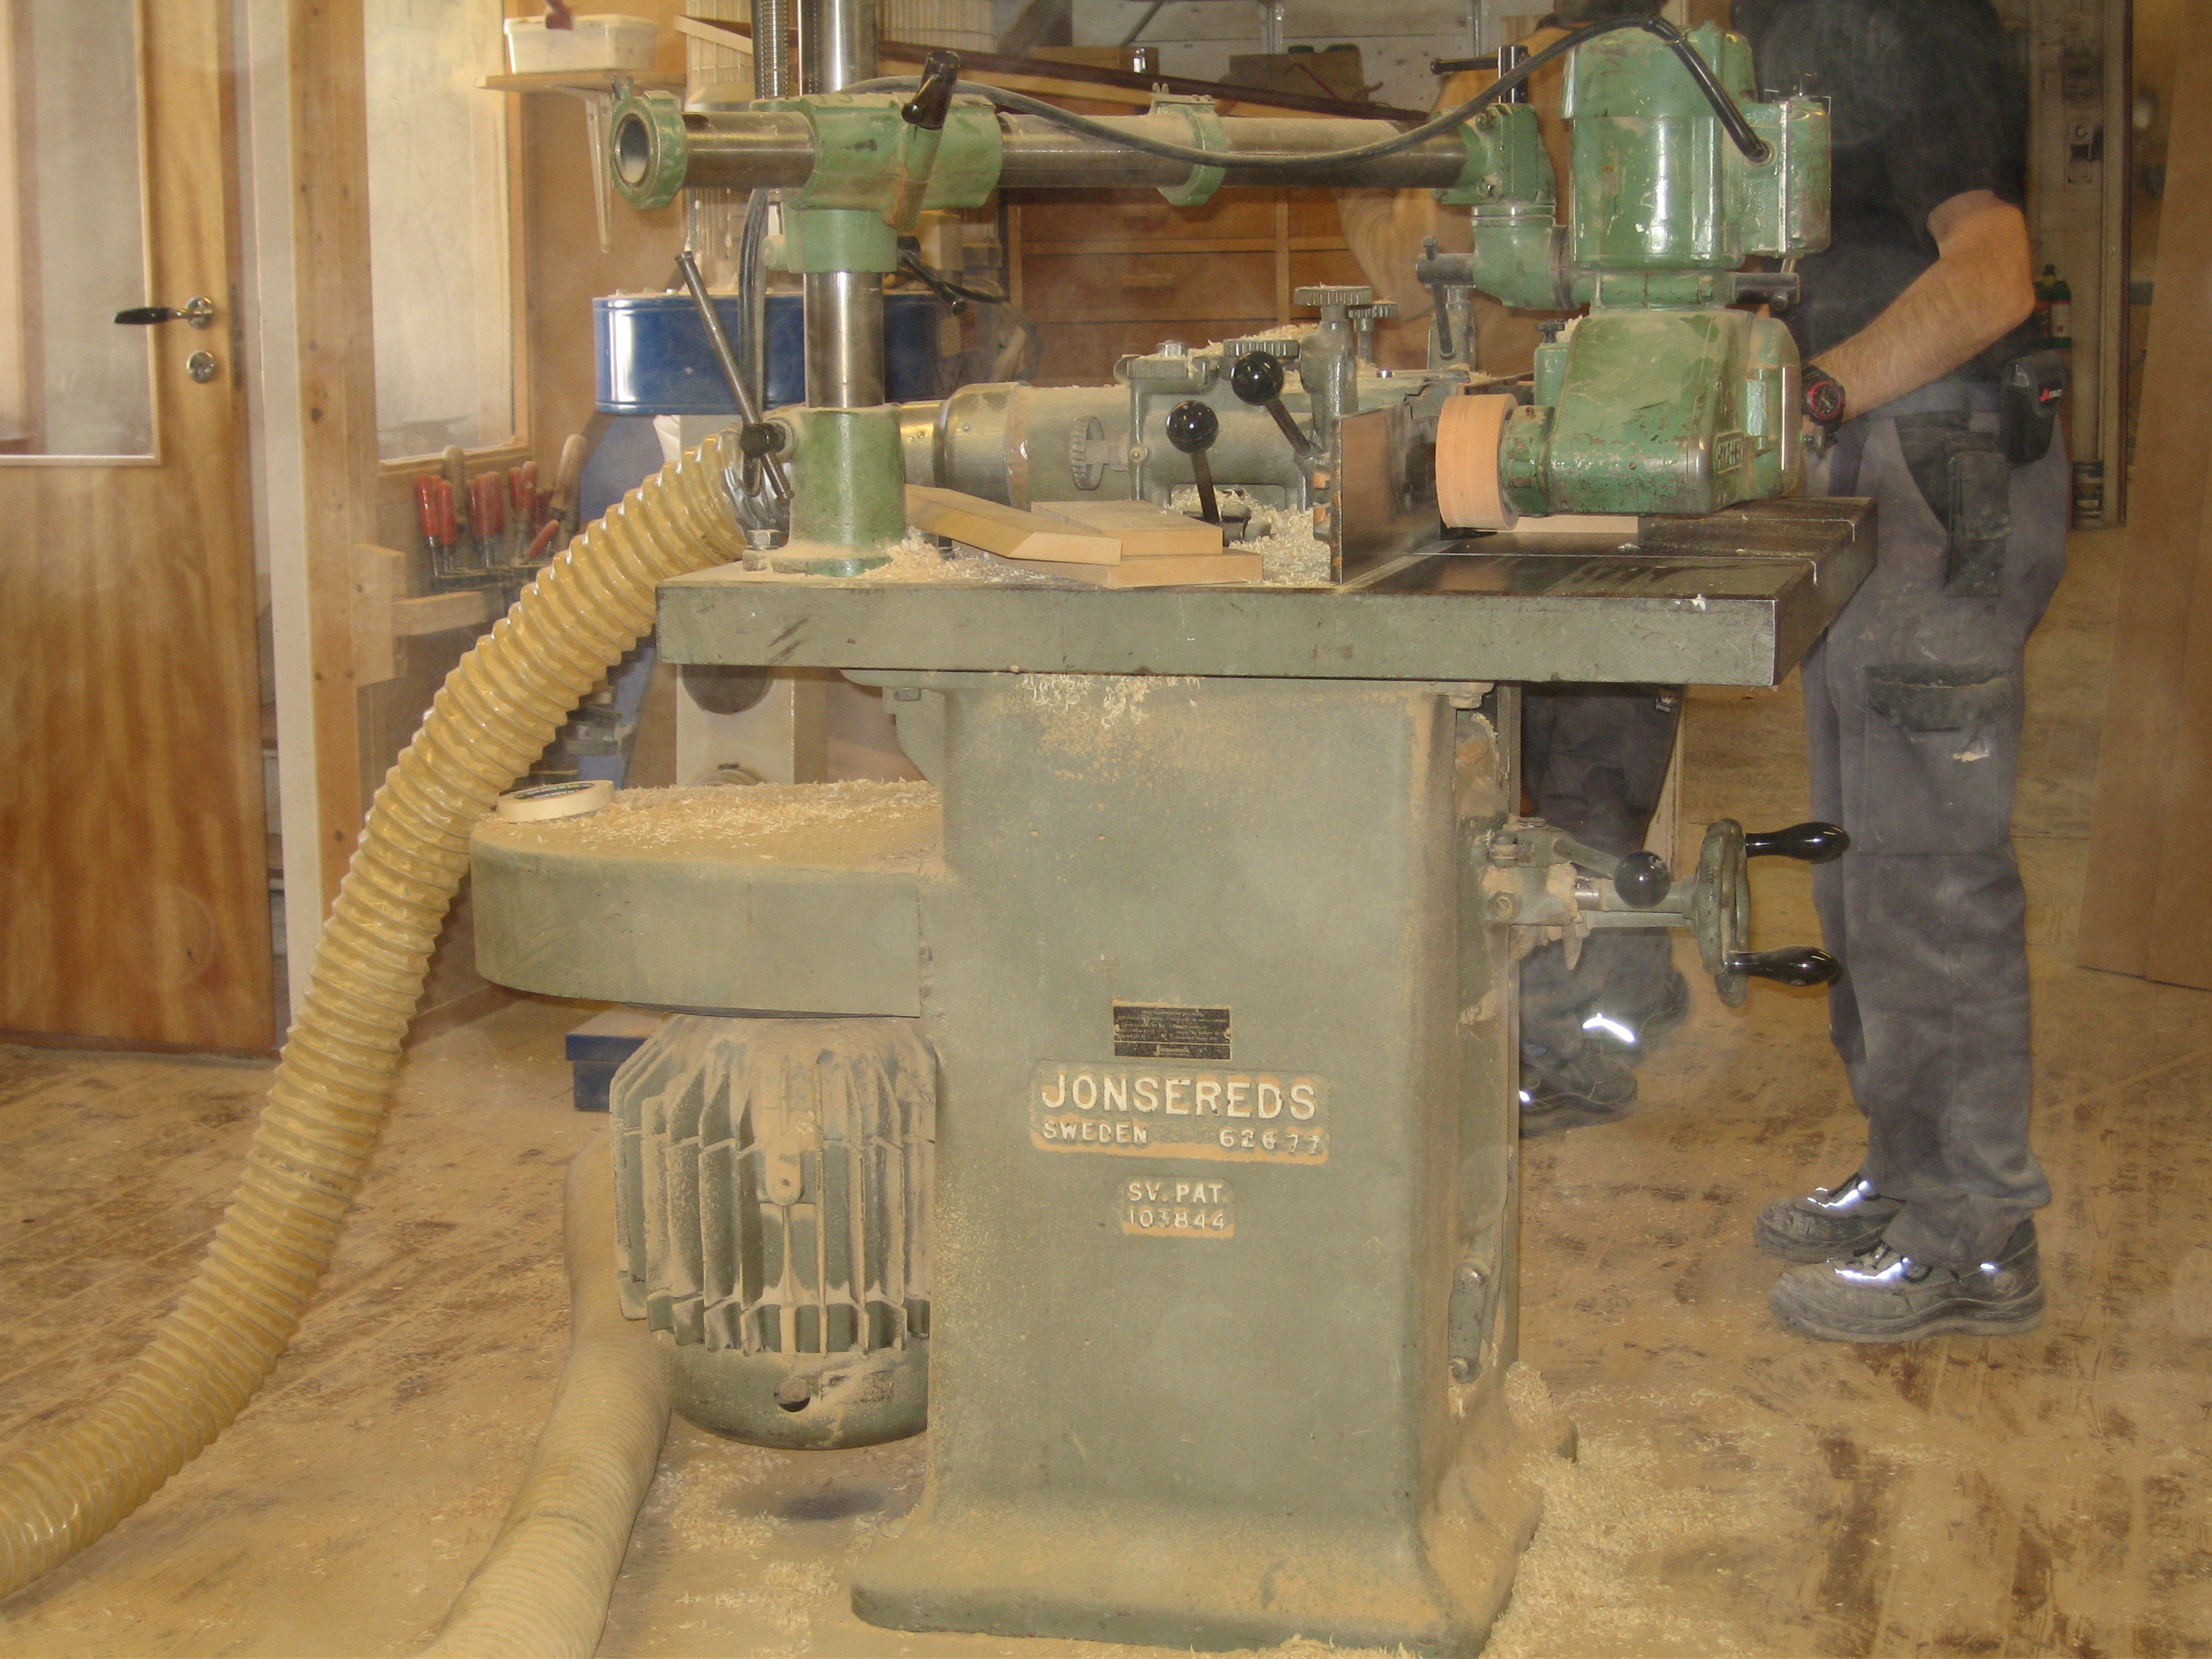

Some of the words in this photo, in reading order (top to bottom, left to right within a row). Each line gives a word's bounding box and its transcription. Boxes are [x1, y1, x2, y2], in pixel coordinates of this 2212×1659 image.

[1041, 1074, 1316, 1120] JONSEREDS
[1043, 1120, 1148, 1145] SWEDEN
[1218, 1128, 1321, 1155] 62677
[1128, 1208, 1226, 1230] 103844
